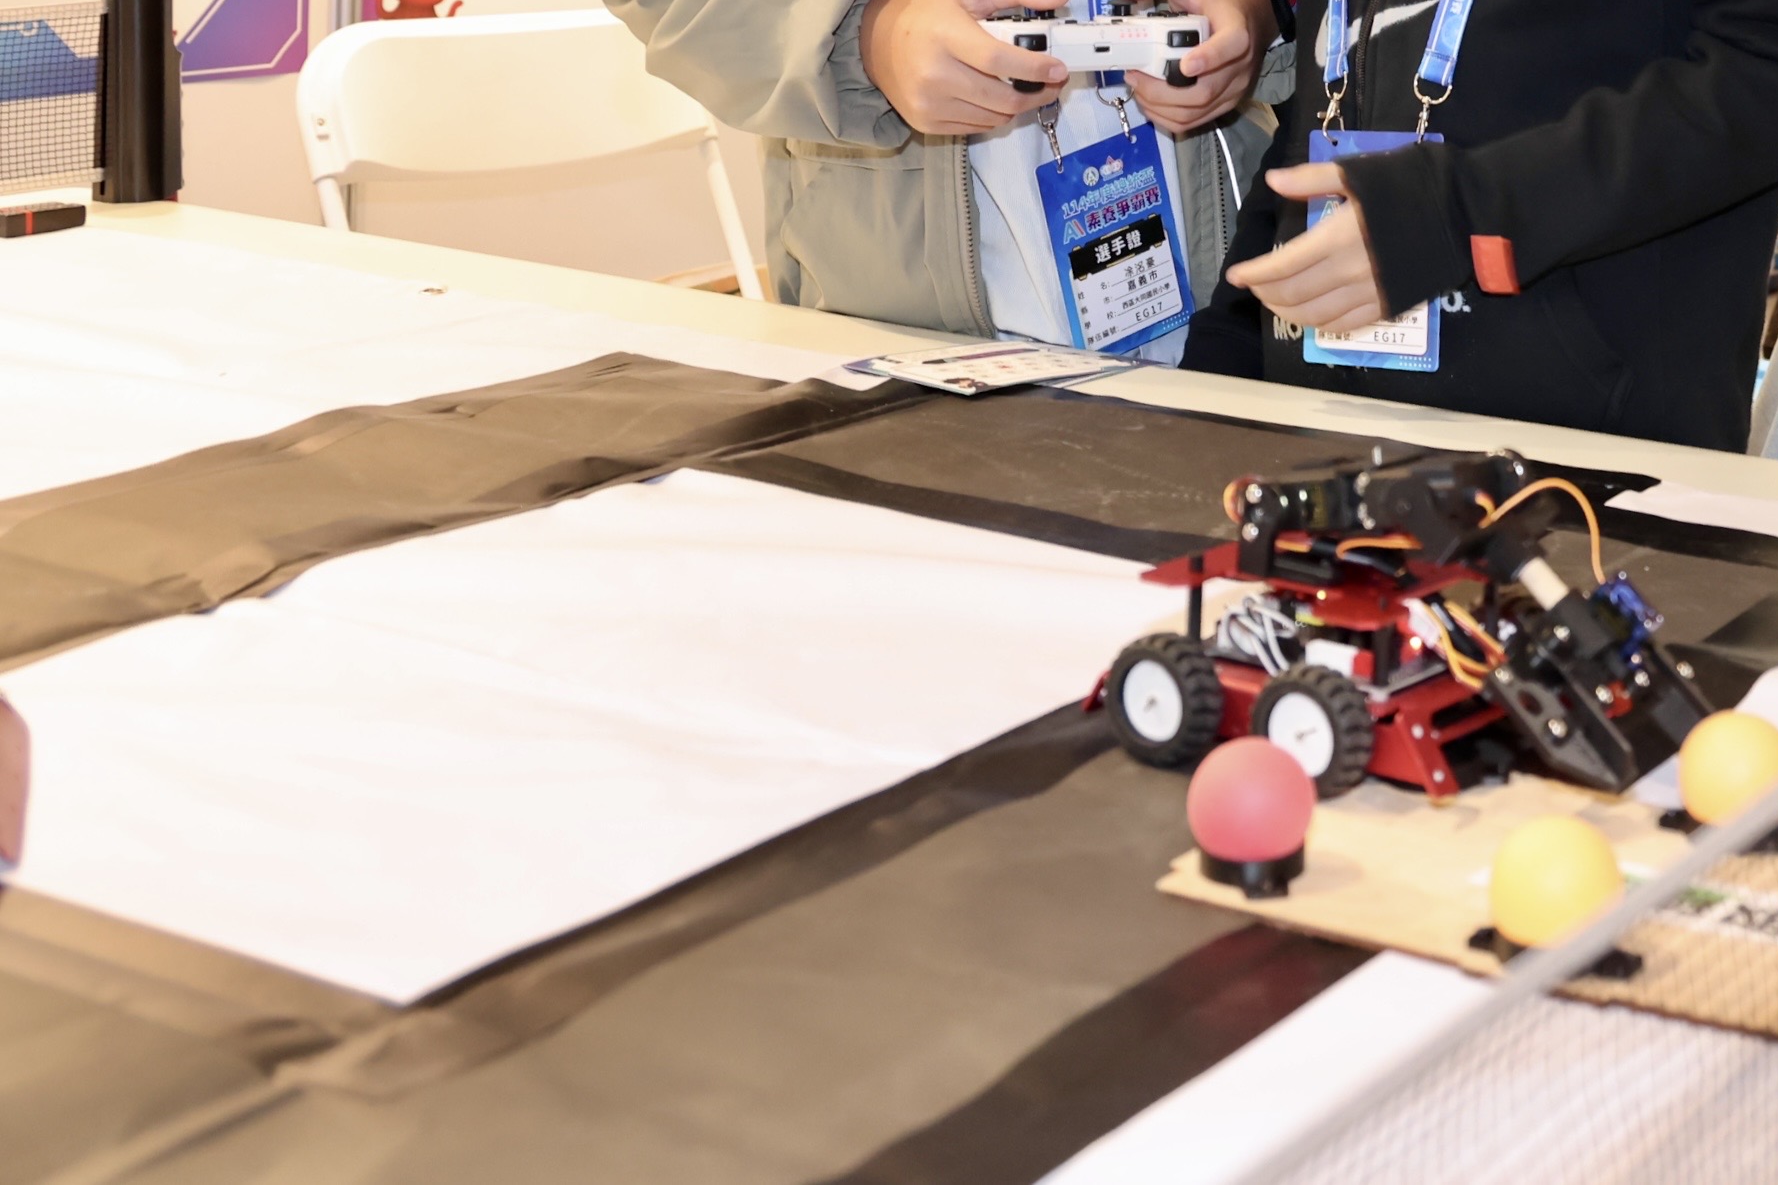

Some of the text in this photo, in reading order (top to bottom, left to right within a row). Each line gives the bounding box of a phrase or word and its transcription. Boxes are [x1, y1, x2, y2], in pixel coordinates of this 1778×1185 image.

[1094, 229, 1143, 265] 選手證
[1127, 270, 1159, 292] 嘉義市
[1374, 331, 1406, 343] EG17
